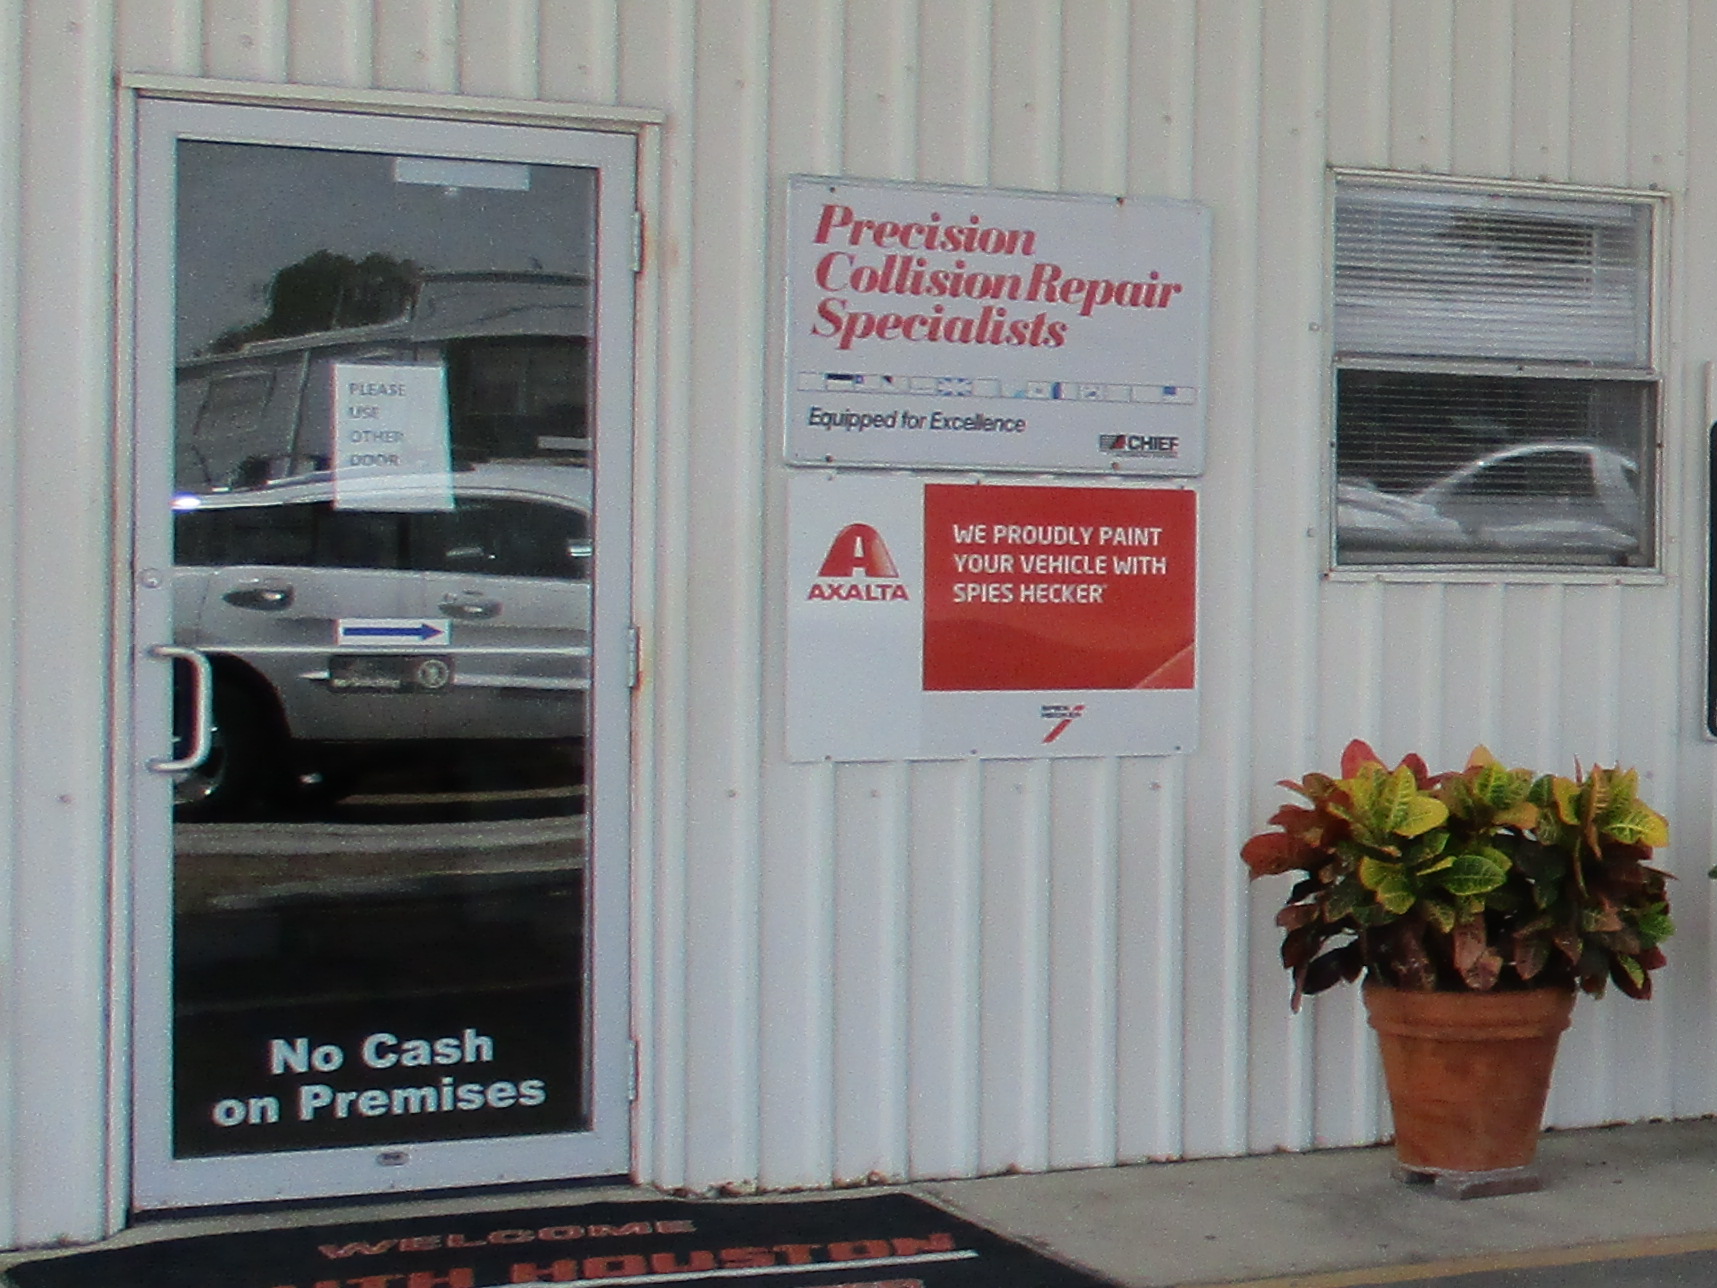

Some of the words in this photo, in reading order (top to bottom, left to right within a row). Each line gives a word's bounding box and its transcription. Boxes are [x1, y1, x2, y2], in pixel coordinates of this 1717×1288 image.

[812, 203, 1038, 256] Precision
[814, 250, 1024, 302] Collision
[1025, 262, 1183, 318] Repair
[811, 296, 1069, 350] Specialists
[349, 382, 406, 396] PLEASE
[349, 405, 380, 419] USE
[807, 406, 897, 431] Equipped
[900, 409, 927, 429] for
[929, 412, 1027, 433] Excellence
[1127, 434, 1180, 451] CHIEF
[952, 523, 987, 545] WE
[993, 524, 1092, 546] PROUDLY
[1099, 526, 1163, 547] PAINT
[952, 554, 1015, 575] YOUR
[1020, 554, 1107, 575] VEHICLE
[1112, 556, 1167, 576] WITH
[806, 583, 911, 602] AXALTA
[952, 583, 1014, 603] SPIES
[1019, 583, 1105, 603] HECKER
[269, 1037, 344, 1075] No
[361, 1028, 494, 1069] Cash
[212, 1095, 280, 1128] on
[297, 1076, 547, 1121] Premises
[317, 1219, 698, 1260] WELCOME
[509, 1232, 956, 1285] HOUSTON
